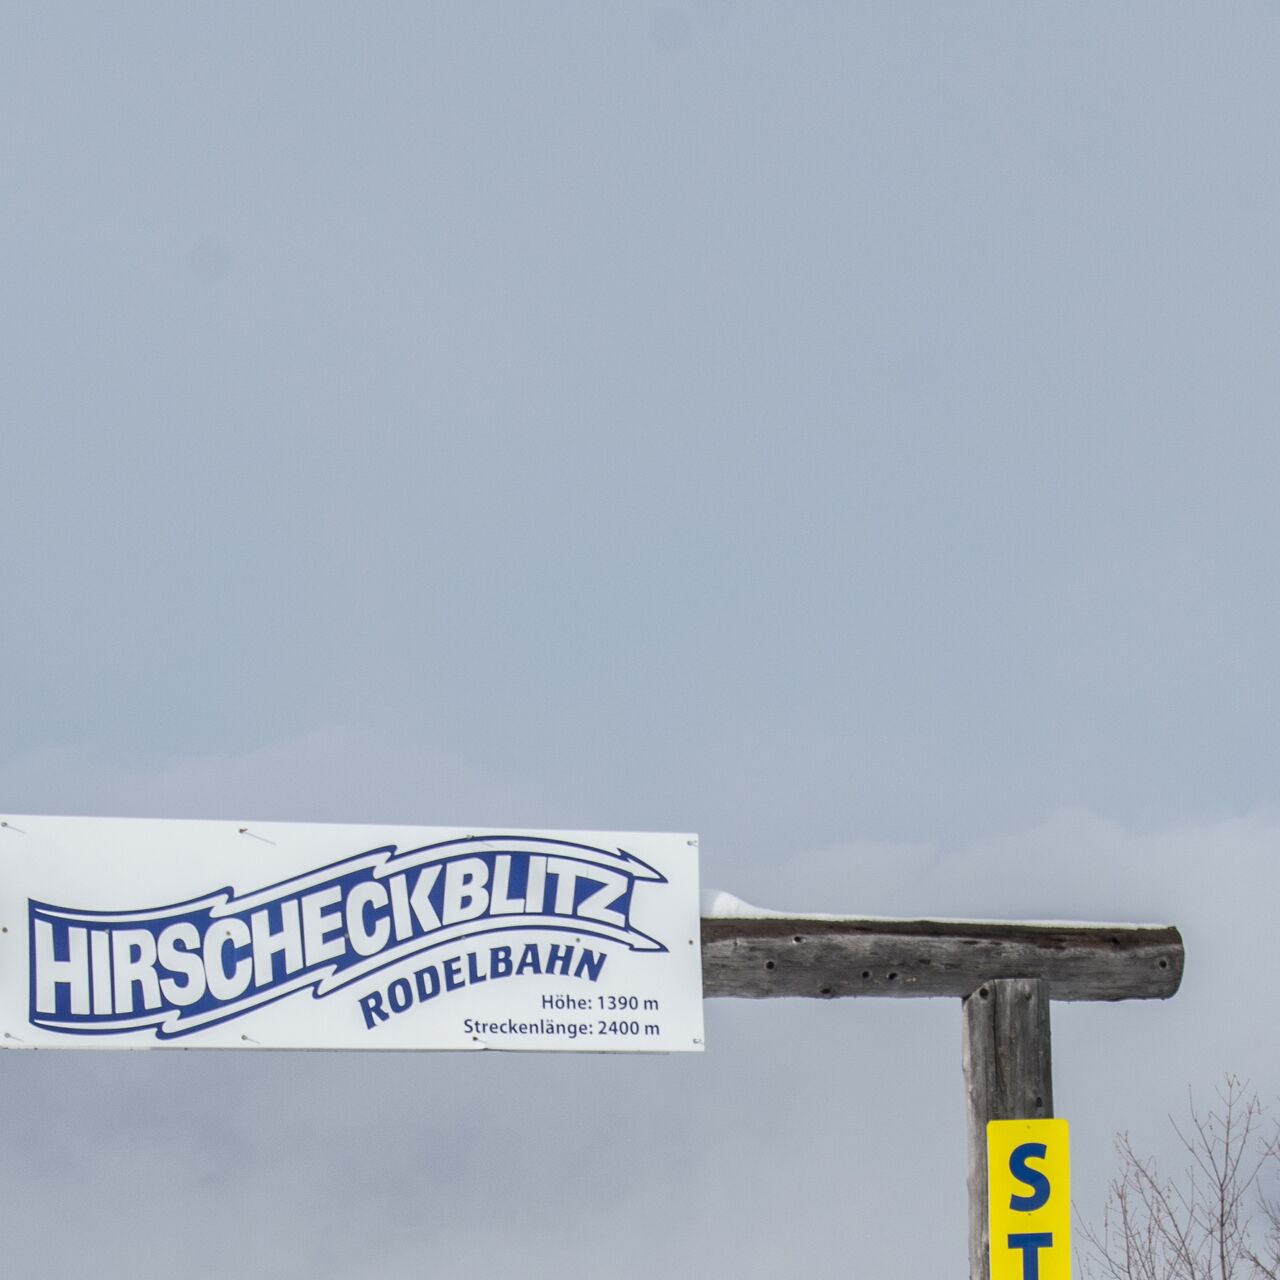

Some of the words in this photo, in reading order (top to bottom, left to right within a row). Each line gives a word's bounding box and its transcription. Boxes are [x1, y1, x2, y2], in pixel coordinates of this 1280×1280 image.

[34, 853, 636, 1017] HIRSCHECKBLITZ
[358, 943, 608, 1030] RODELBAHN
[542, 994, 593, 1011] Höhe:
[598, 996, 639, 1011] 1390
[644, 999, 659, 1011] m
[463, 1018, 594, 1038] Streckenlänge:
[598, 1021, 640, 1035] 2400
[645, 1024, 660, 1036] m
